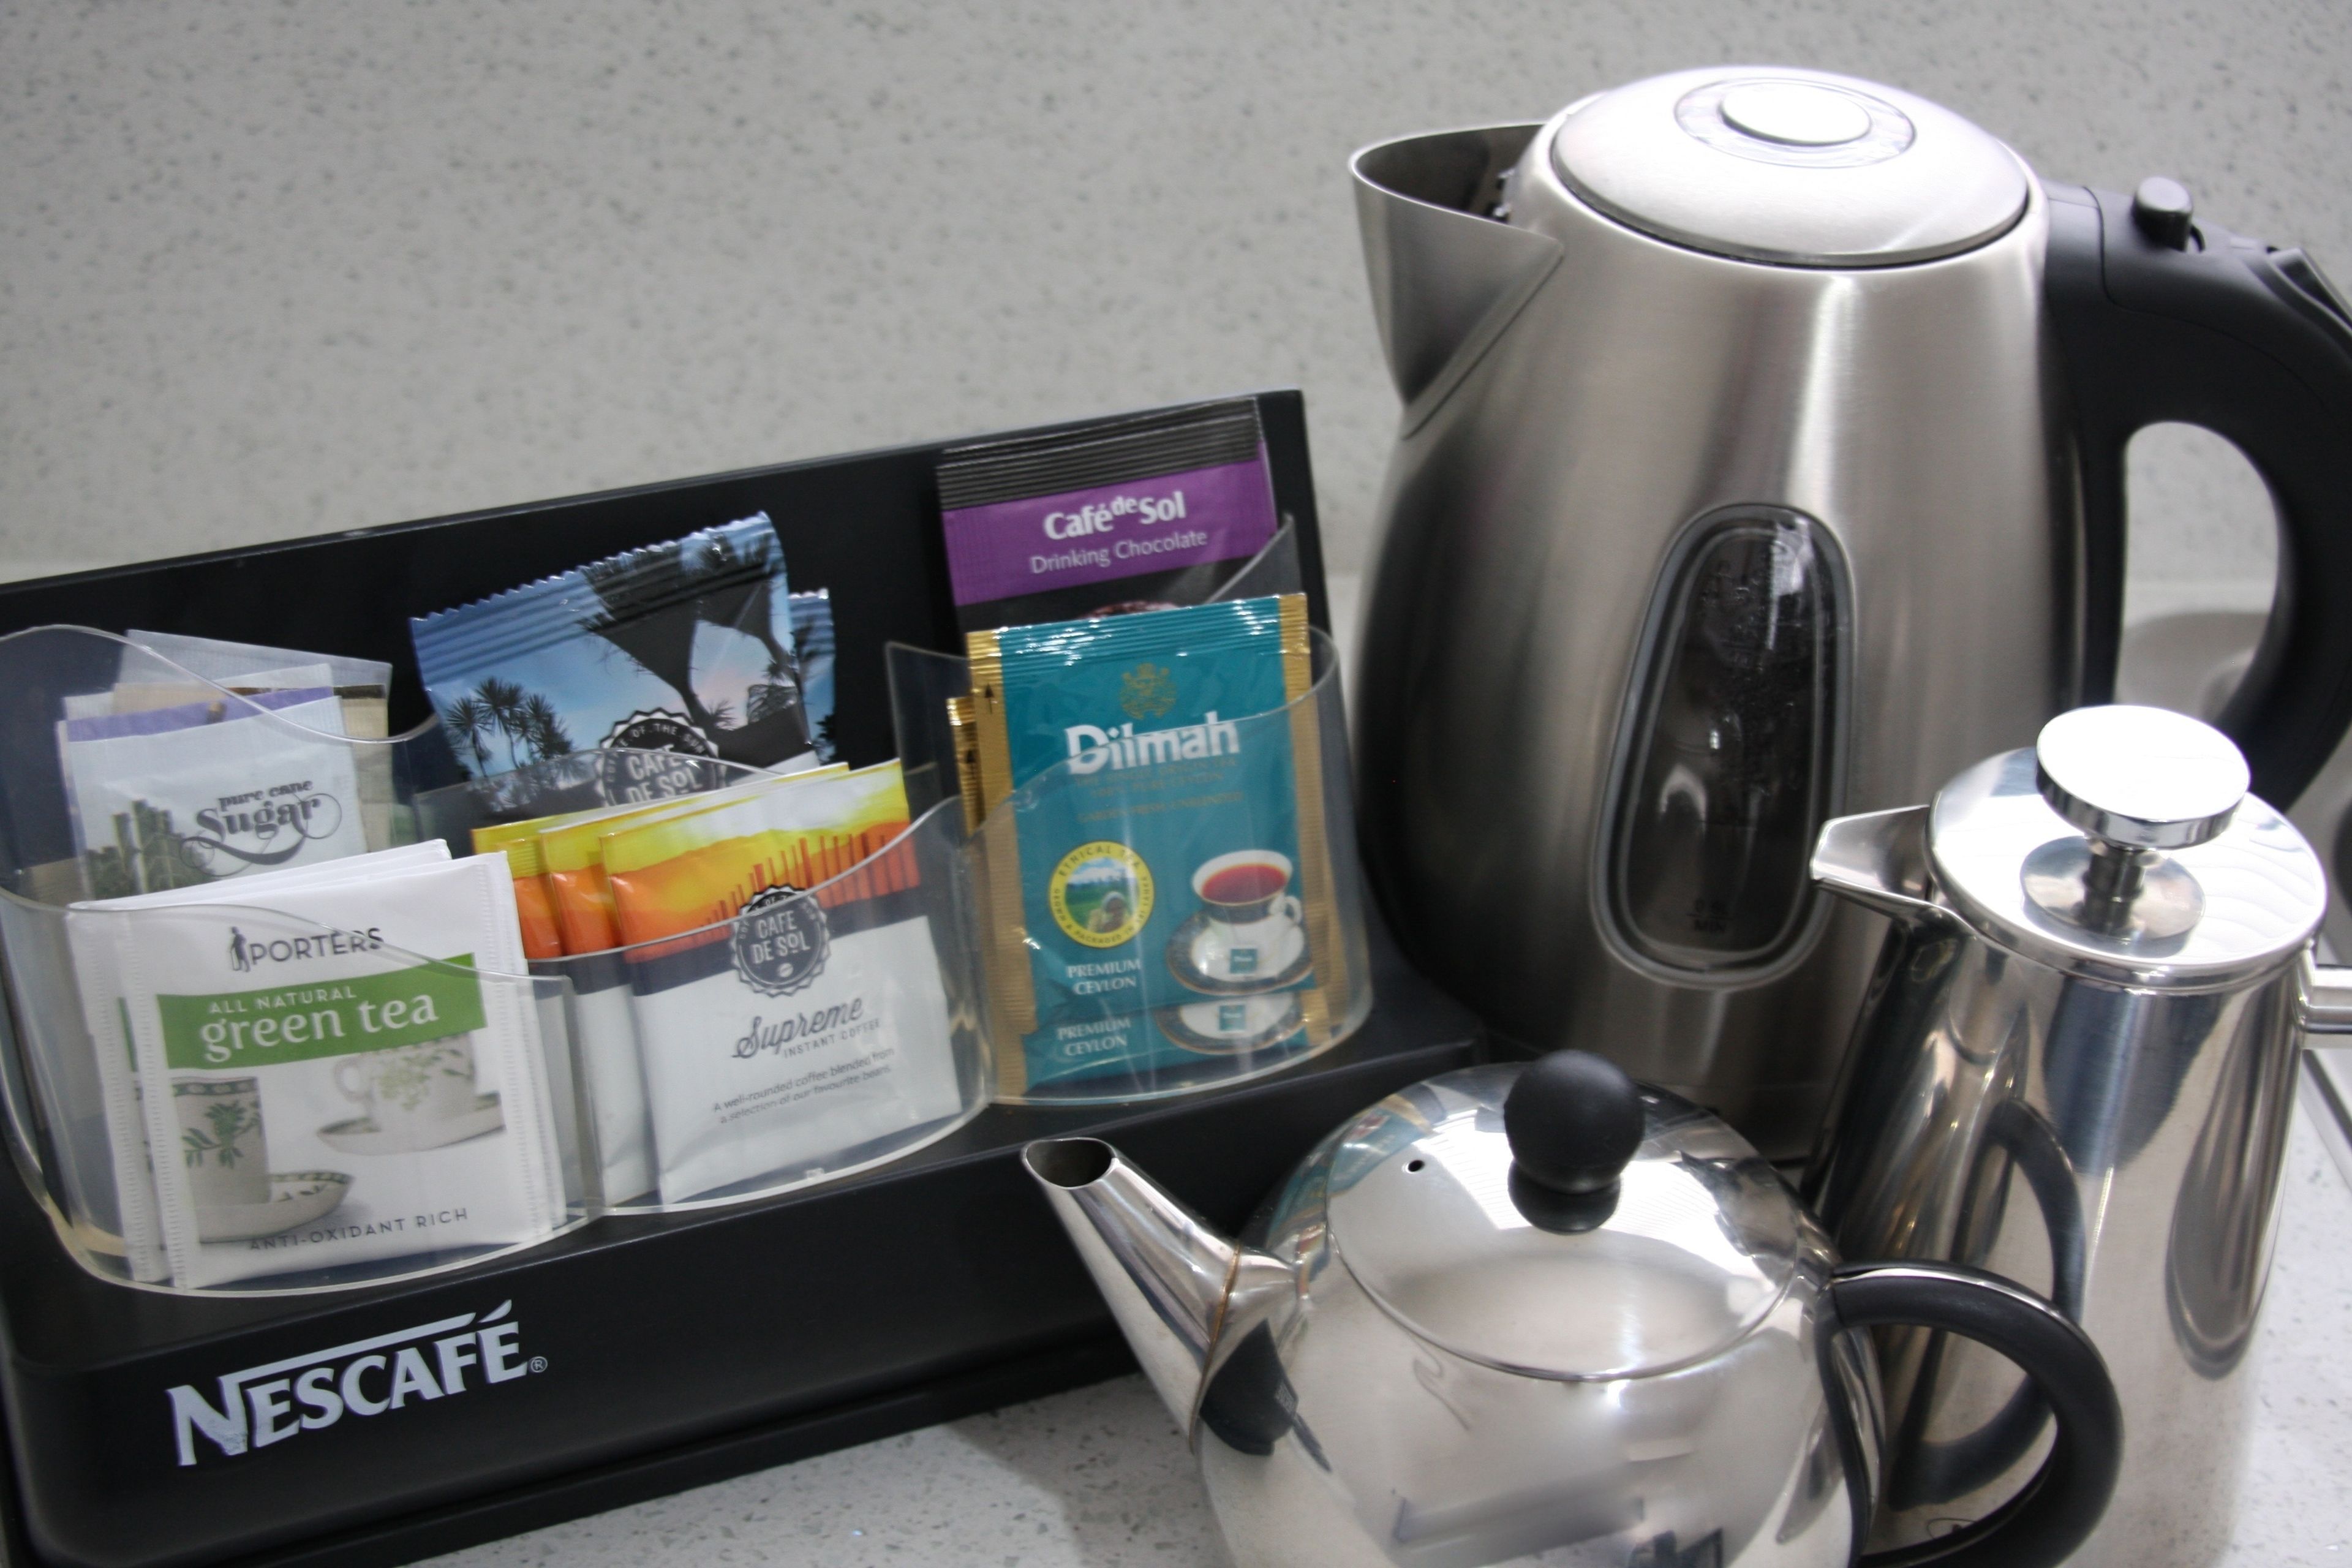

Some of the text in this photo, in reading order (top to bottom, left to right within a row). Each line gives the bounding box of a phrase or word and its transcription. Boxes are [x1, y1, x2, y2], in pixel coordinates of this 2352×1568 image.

[1044, 491, 1187, 540] Café de Sol
[1030, 531, 1208, 574] Drinking Chocolate
[631, 726, 646, 737] OF
[654, 723, 678, 734] THE
[1065, 710, 1240, 775] Dilmah
[219, 780, 314, 812] pure cane
[183, 794, 336, 860] Sugar
[756, 910, 797, 939] CAFE
[249, 927, 385, 965] PORTERS
[750, 931, 811, 964] DE SOL
[1066, 959, 1141, 978] PREMIUM
[1073, 976, 1136, 995] CEYLON
[209, 986, 356, 1014] ALL NATURAL
[200, 994, 439, 1063] green tea
[731, 998, 862, 1058] Supreme
[783, 1019, 880, 1058] INSTANT COFFEE
[1057, 1017, 1131, 1040] PREMIUM
[1063, 1035, 1128, 1056] CEYLON
[714, 1047, 895, 1112] A well-rounded coffee blended from
[729, 1101, 777, 1121] selection
[779, 1095, 790, 1106] of
[793, 1090, 812, 1101] our
[813, 1075, 861, 1095] favourite
[251, 1208, 468, 1250] ANTI-OXIDANT RICH
